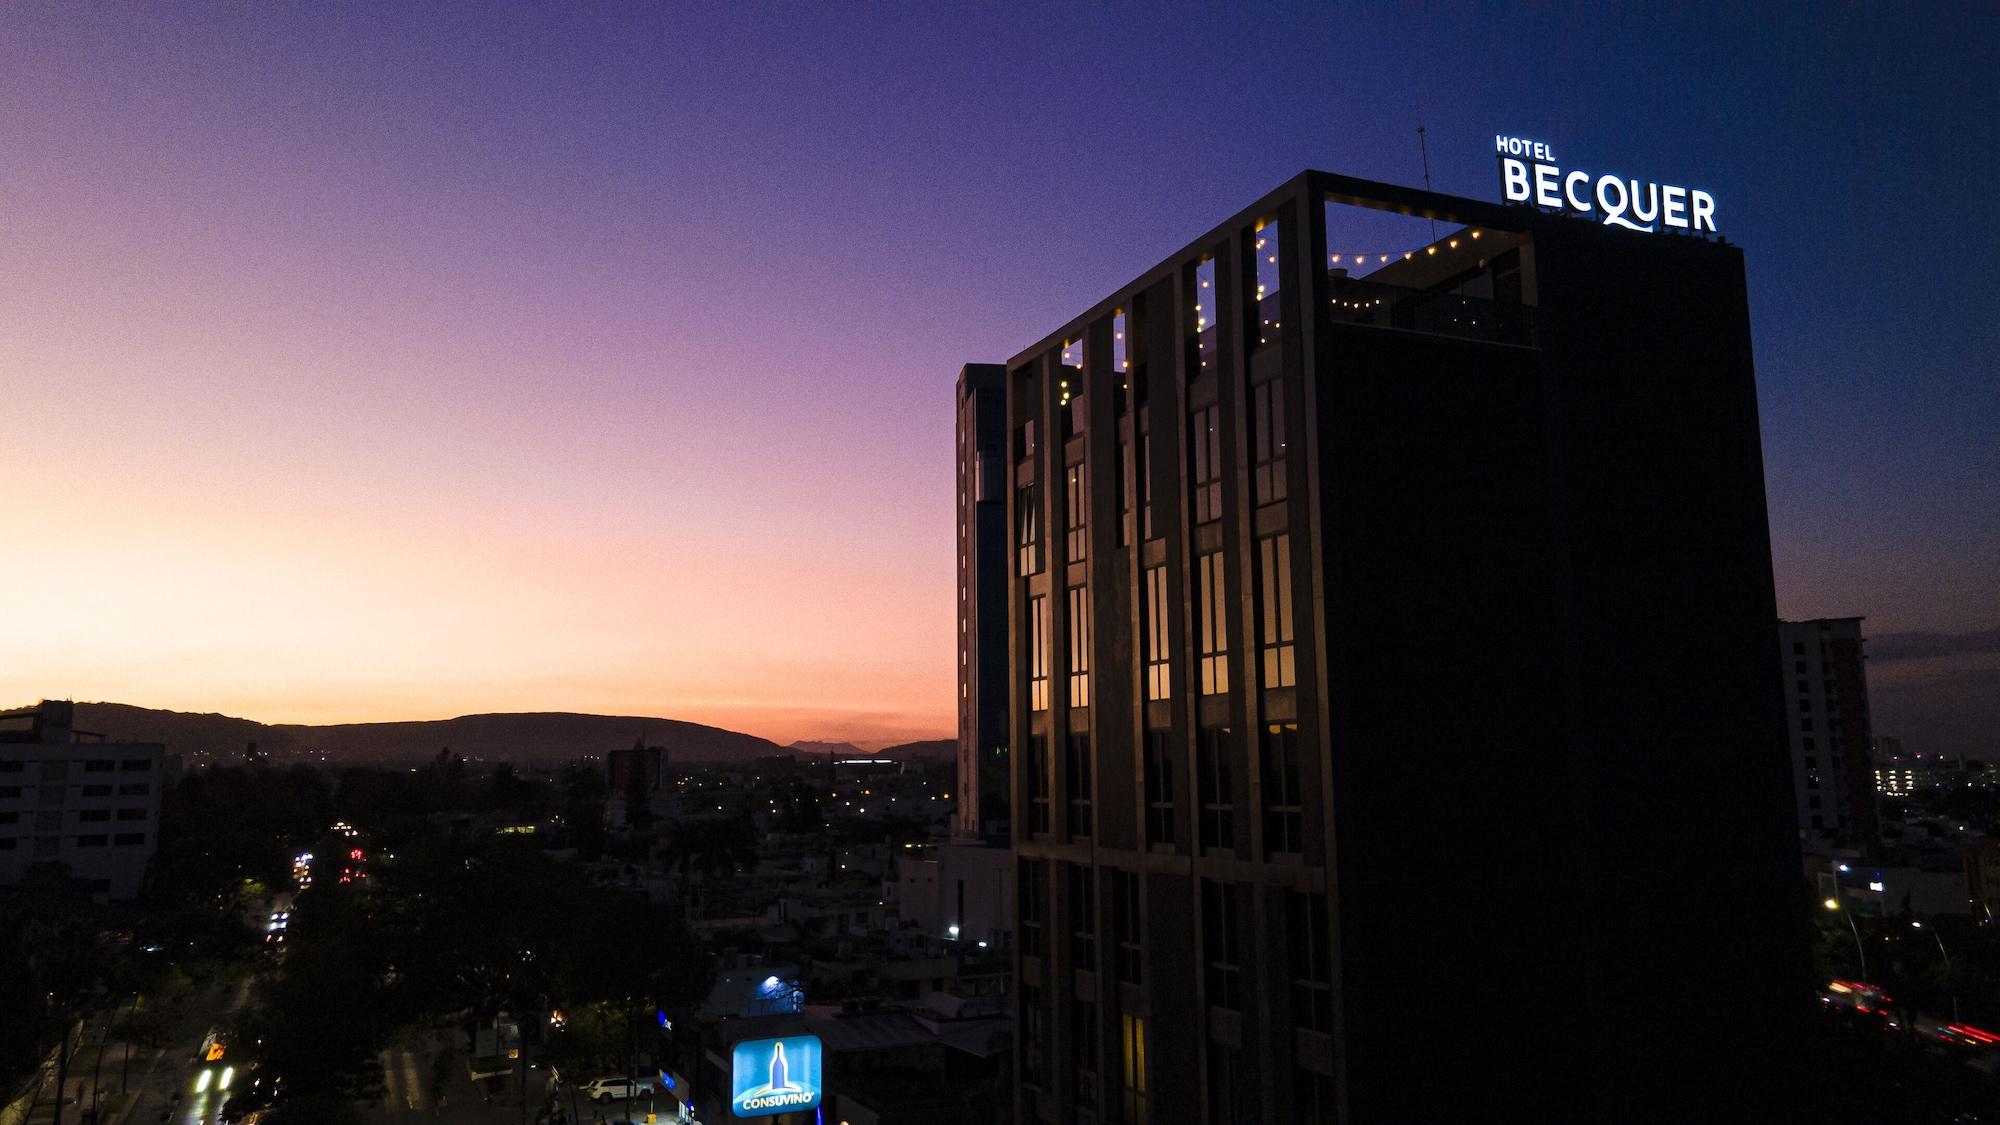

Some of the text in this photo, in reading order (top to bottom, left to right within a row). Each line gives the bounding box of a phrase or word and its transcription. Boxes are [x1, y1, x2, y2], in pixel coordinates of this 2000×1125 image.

[1496, 135, 1555, 161] HOTEL
[1503, 158, 1717, 232] BECQUER
[742, 1092, 813, 1110] CONSUVINO
